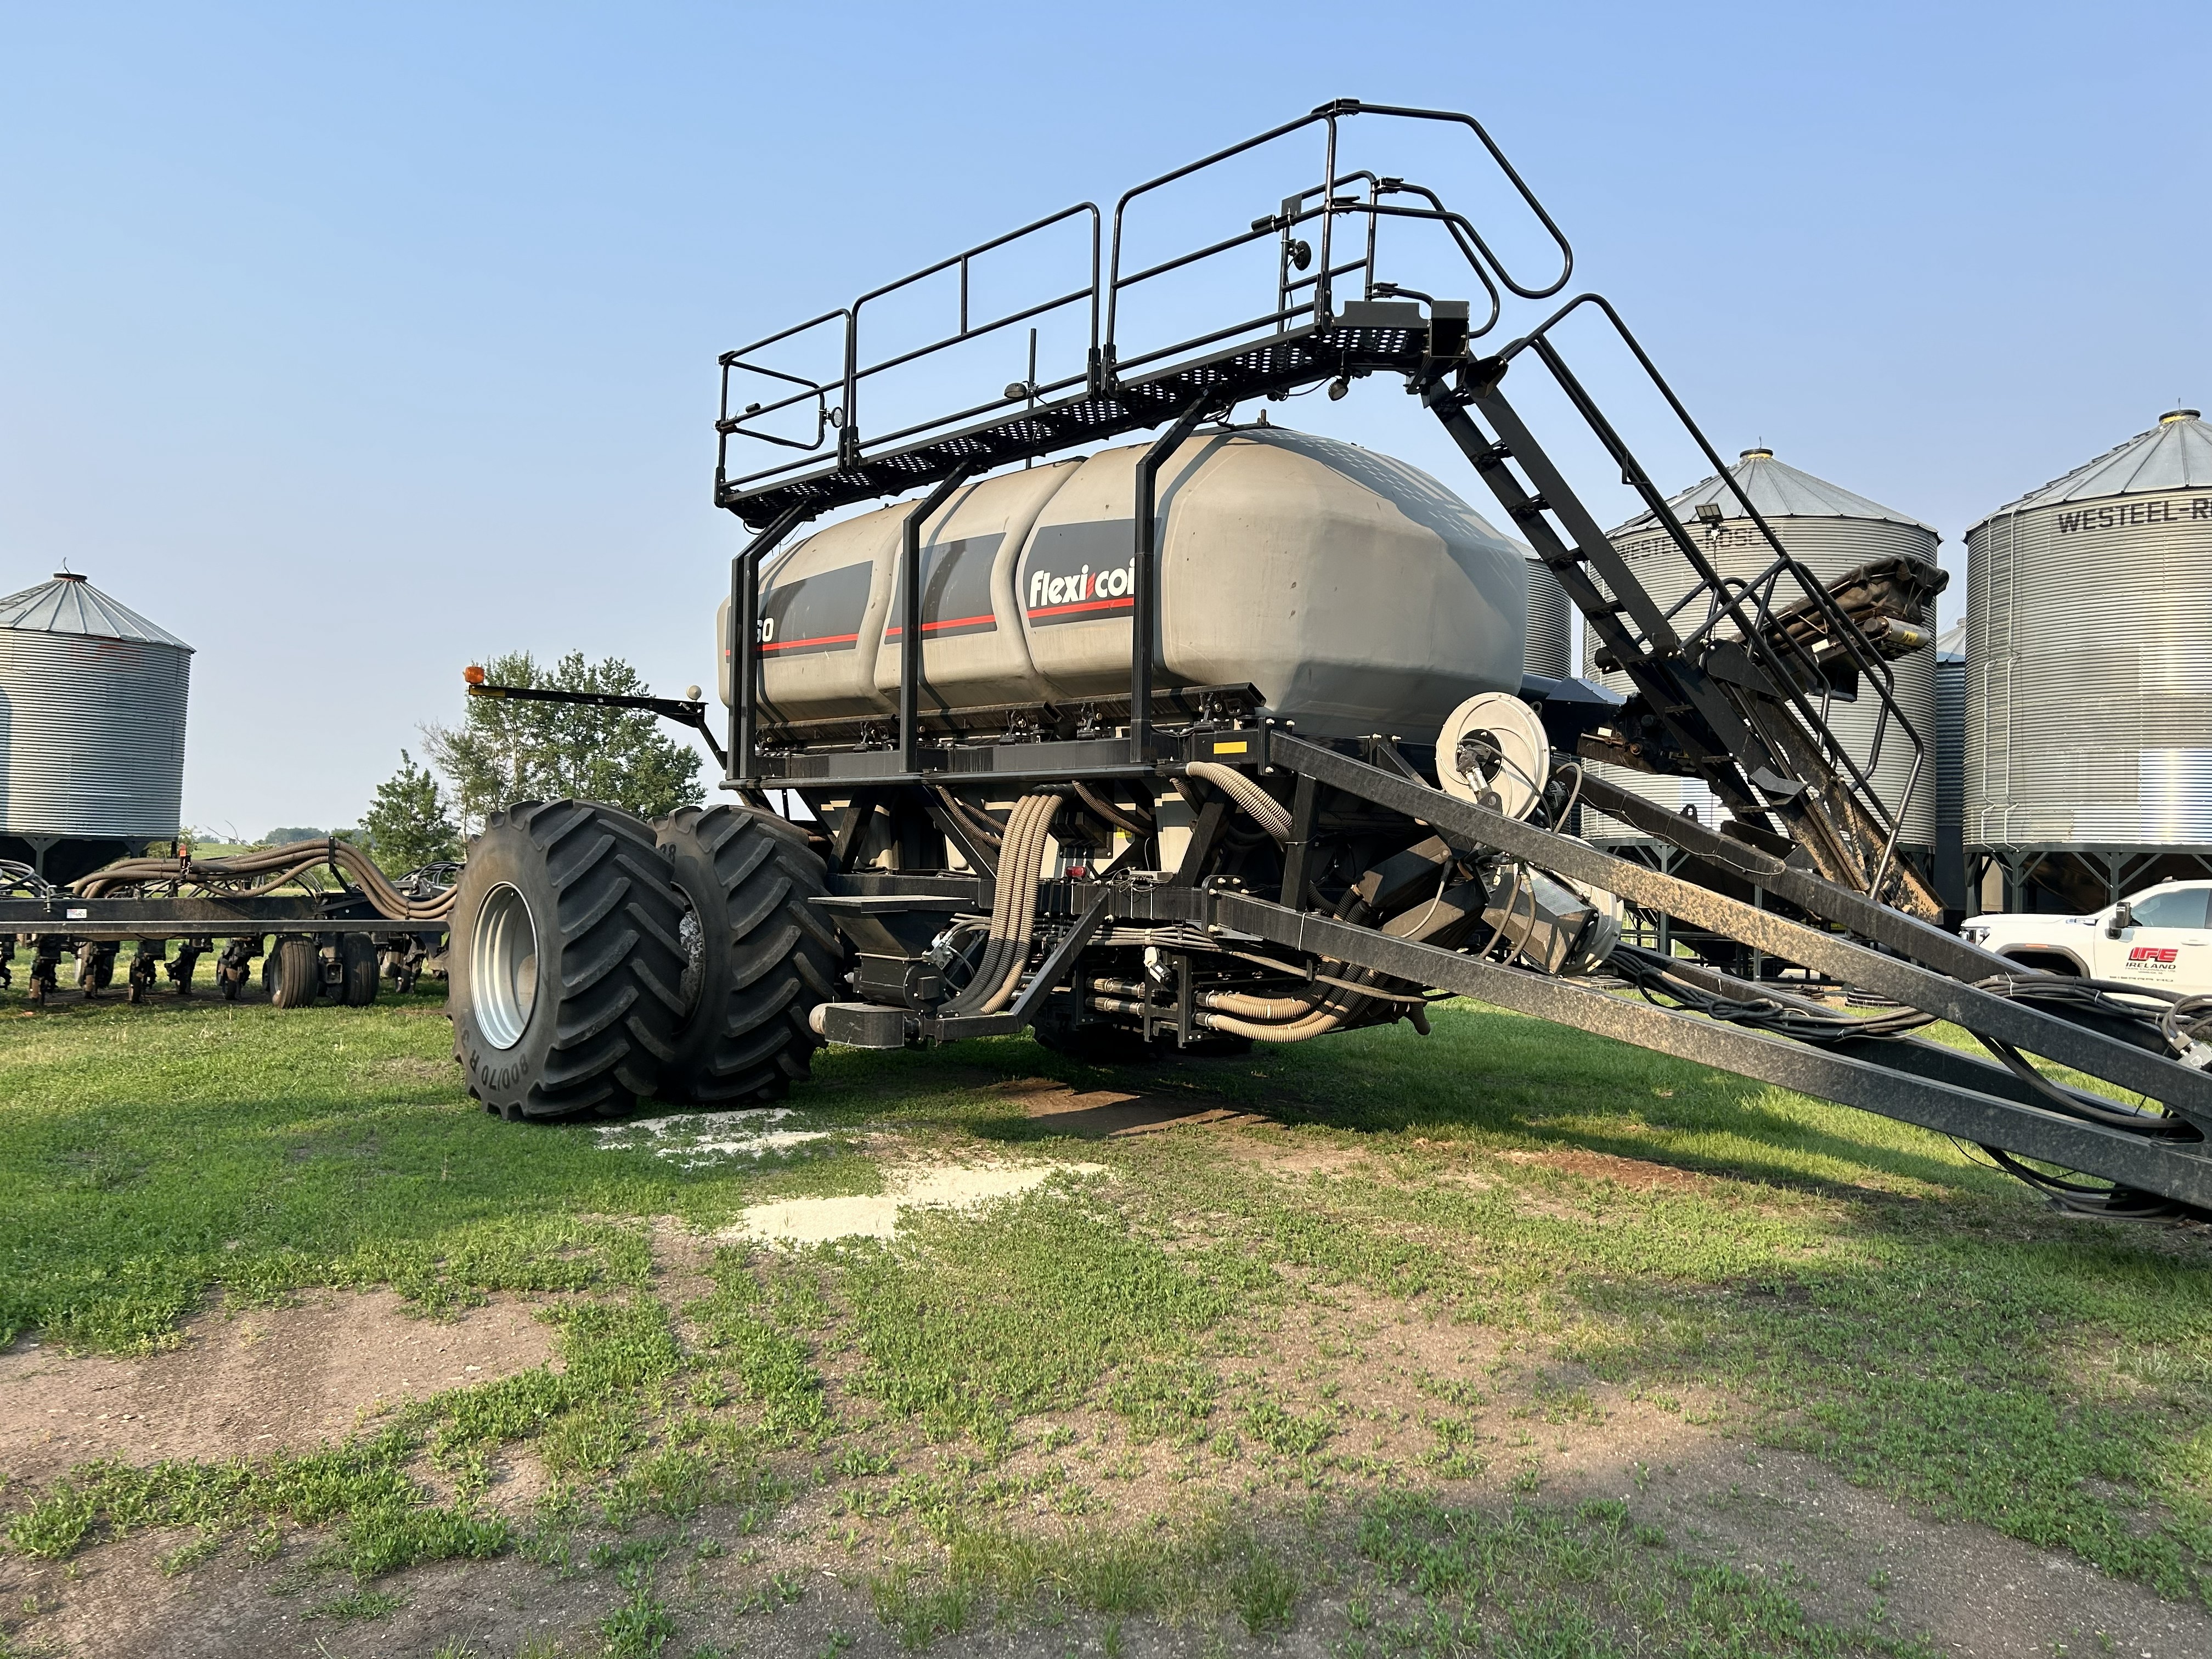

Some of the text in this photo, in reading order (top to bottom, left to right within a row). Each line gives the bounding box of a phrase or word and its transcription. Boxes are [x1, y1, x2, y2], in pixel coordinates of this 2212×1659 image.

[2058, 499, 2212, 533] WESTEEL-R
[1095, 557, 1135, 598] coi
[2128, 947, 2179, 963] IFE
